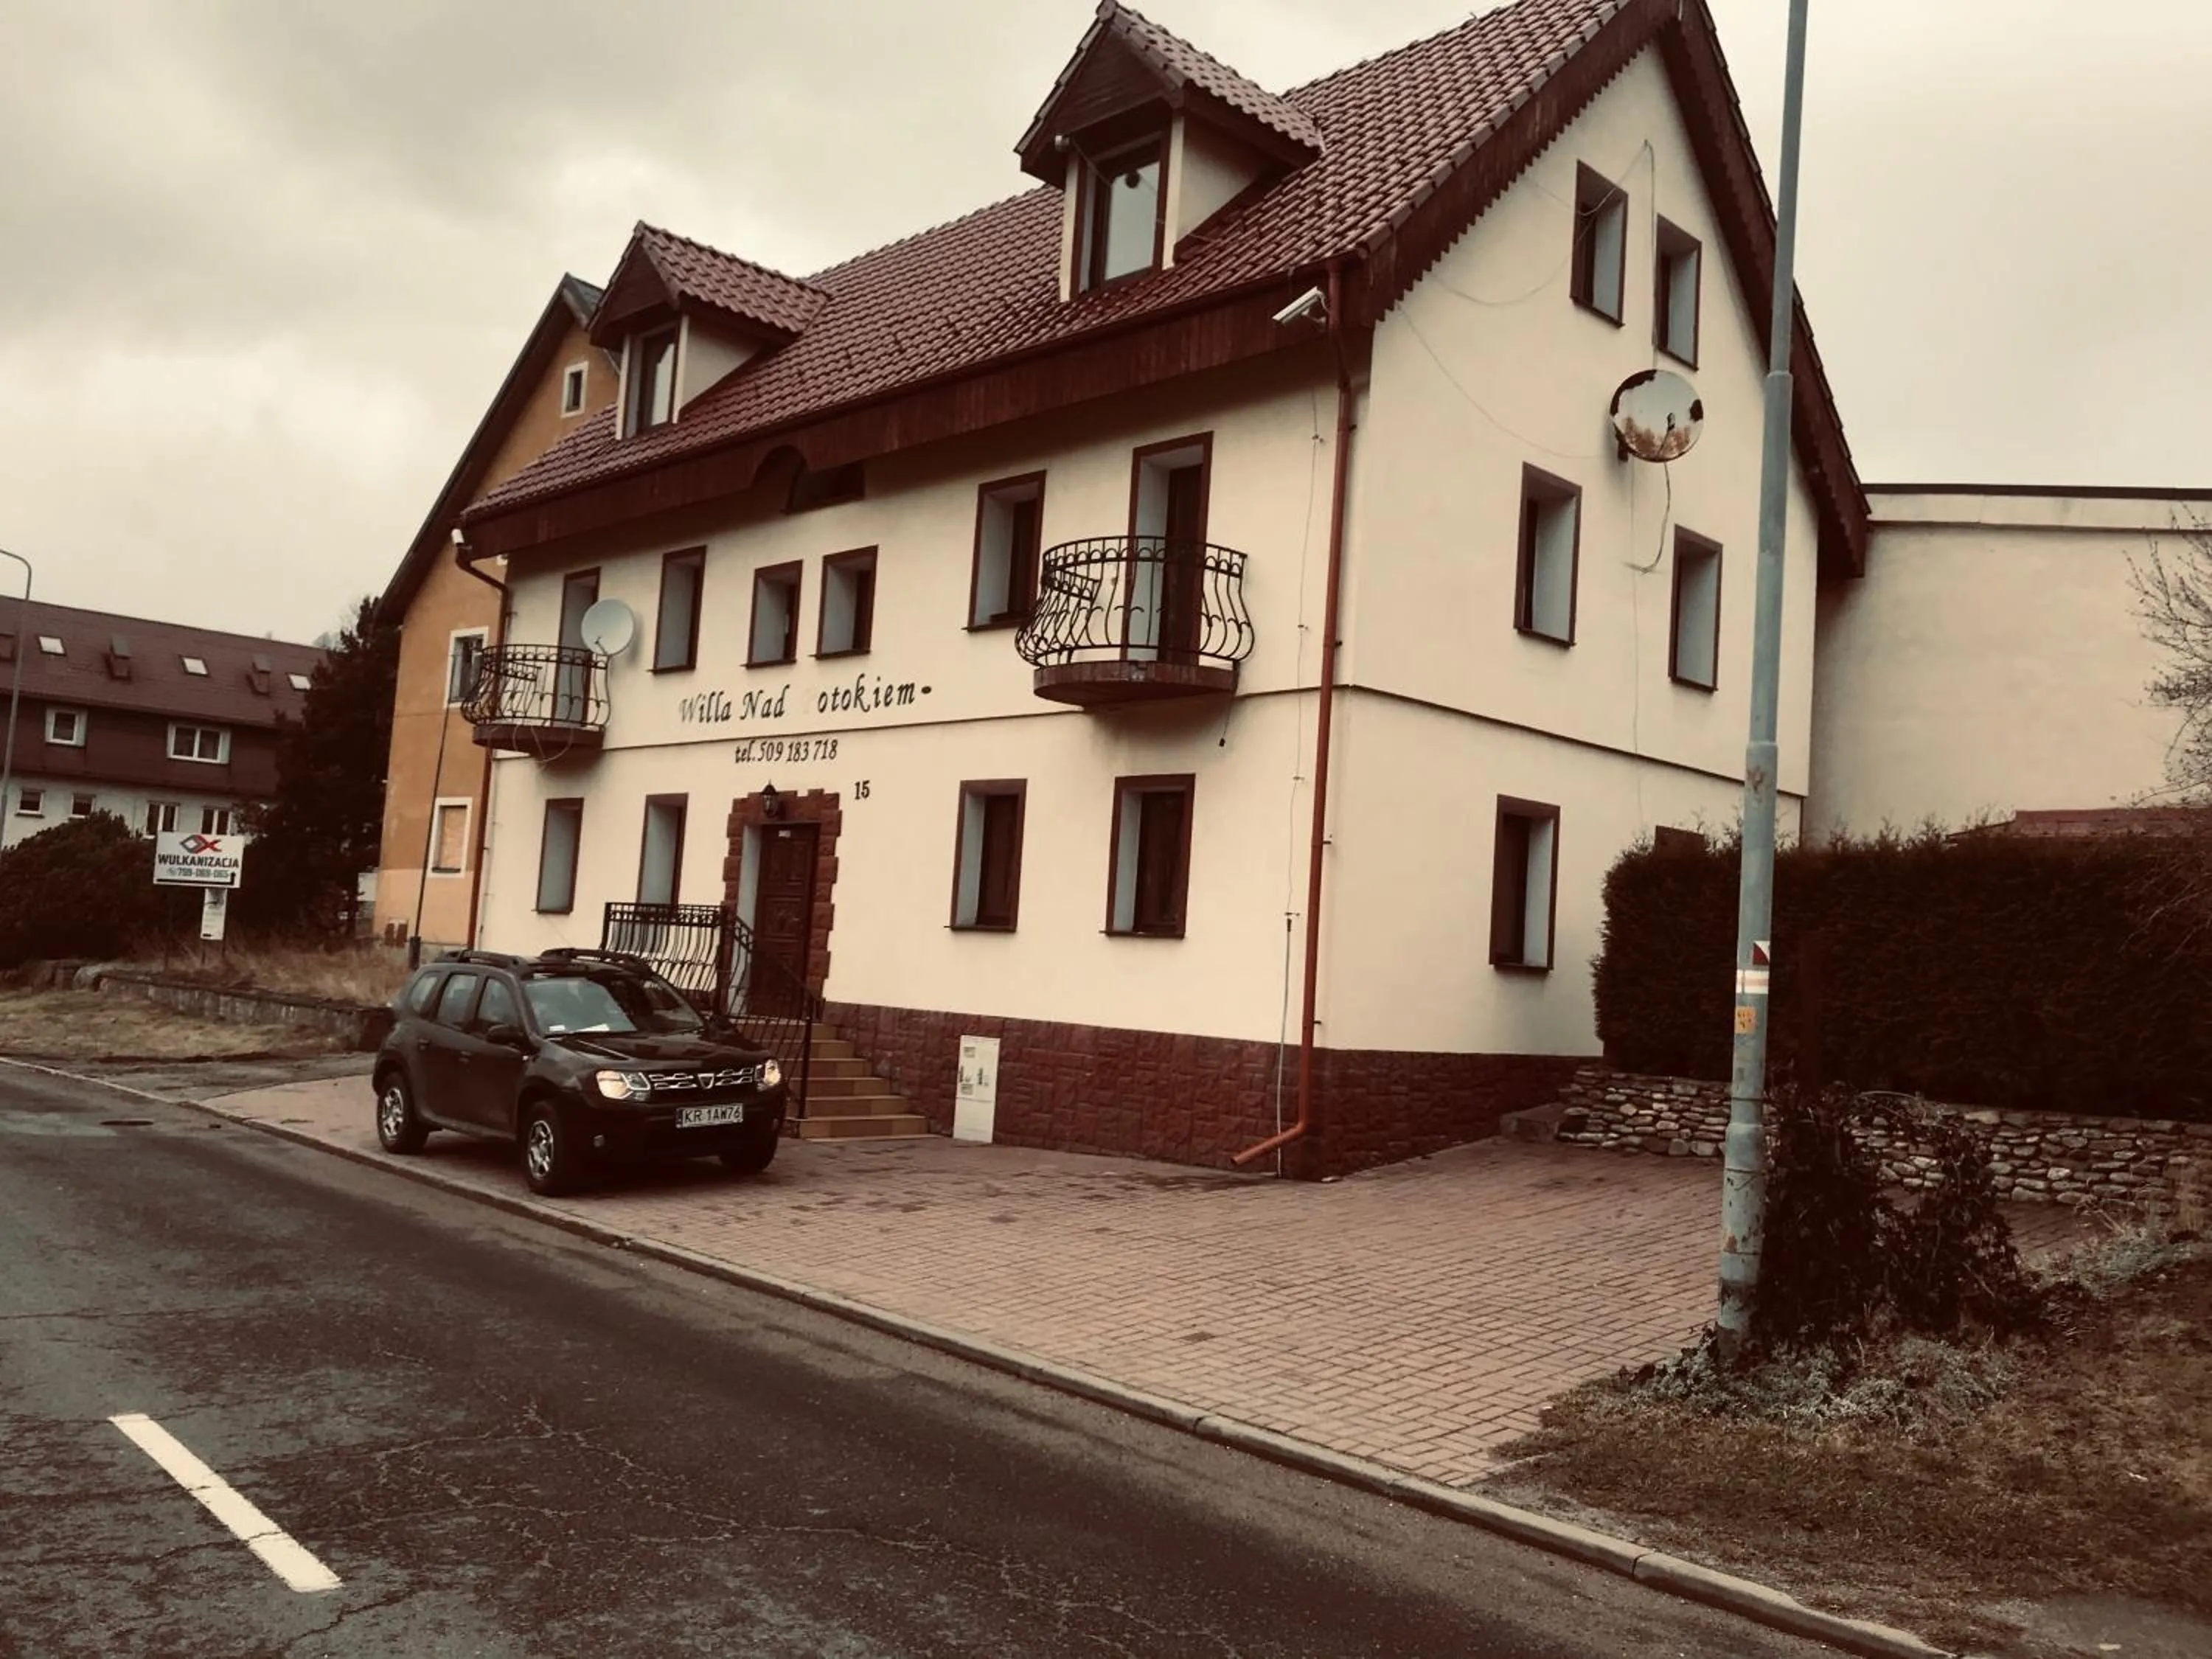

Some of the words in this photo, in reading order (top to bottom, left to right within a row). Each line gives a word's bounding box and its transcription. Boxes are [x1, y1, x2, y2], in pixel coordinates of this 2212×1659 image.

[679, 691, 731, 723] Willa
[740, 684, 790, 720] Nad
[786, 741, 809, 762] 183
[813, 740, 838, 760] 718
[855, 780, 871, 800] 15
[158, 854, 239, 868] WULKANIZACJA
[685, 1109, 702, 1123] KR
